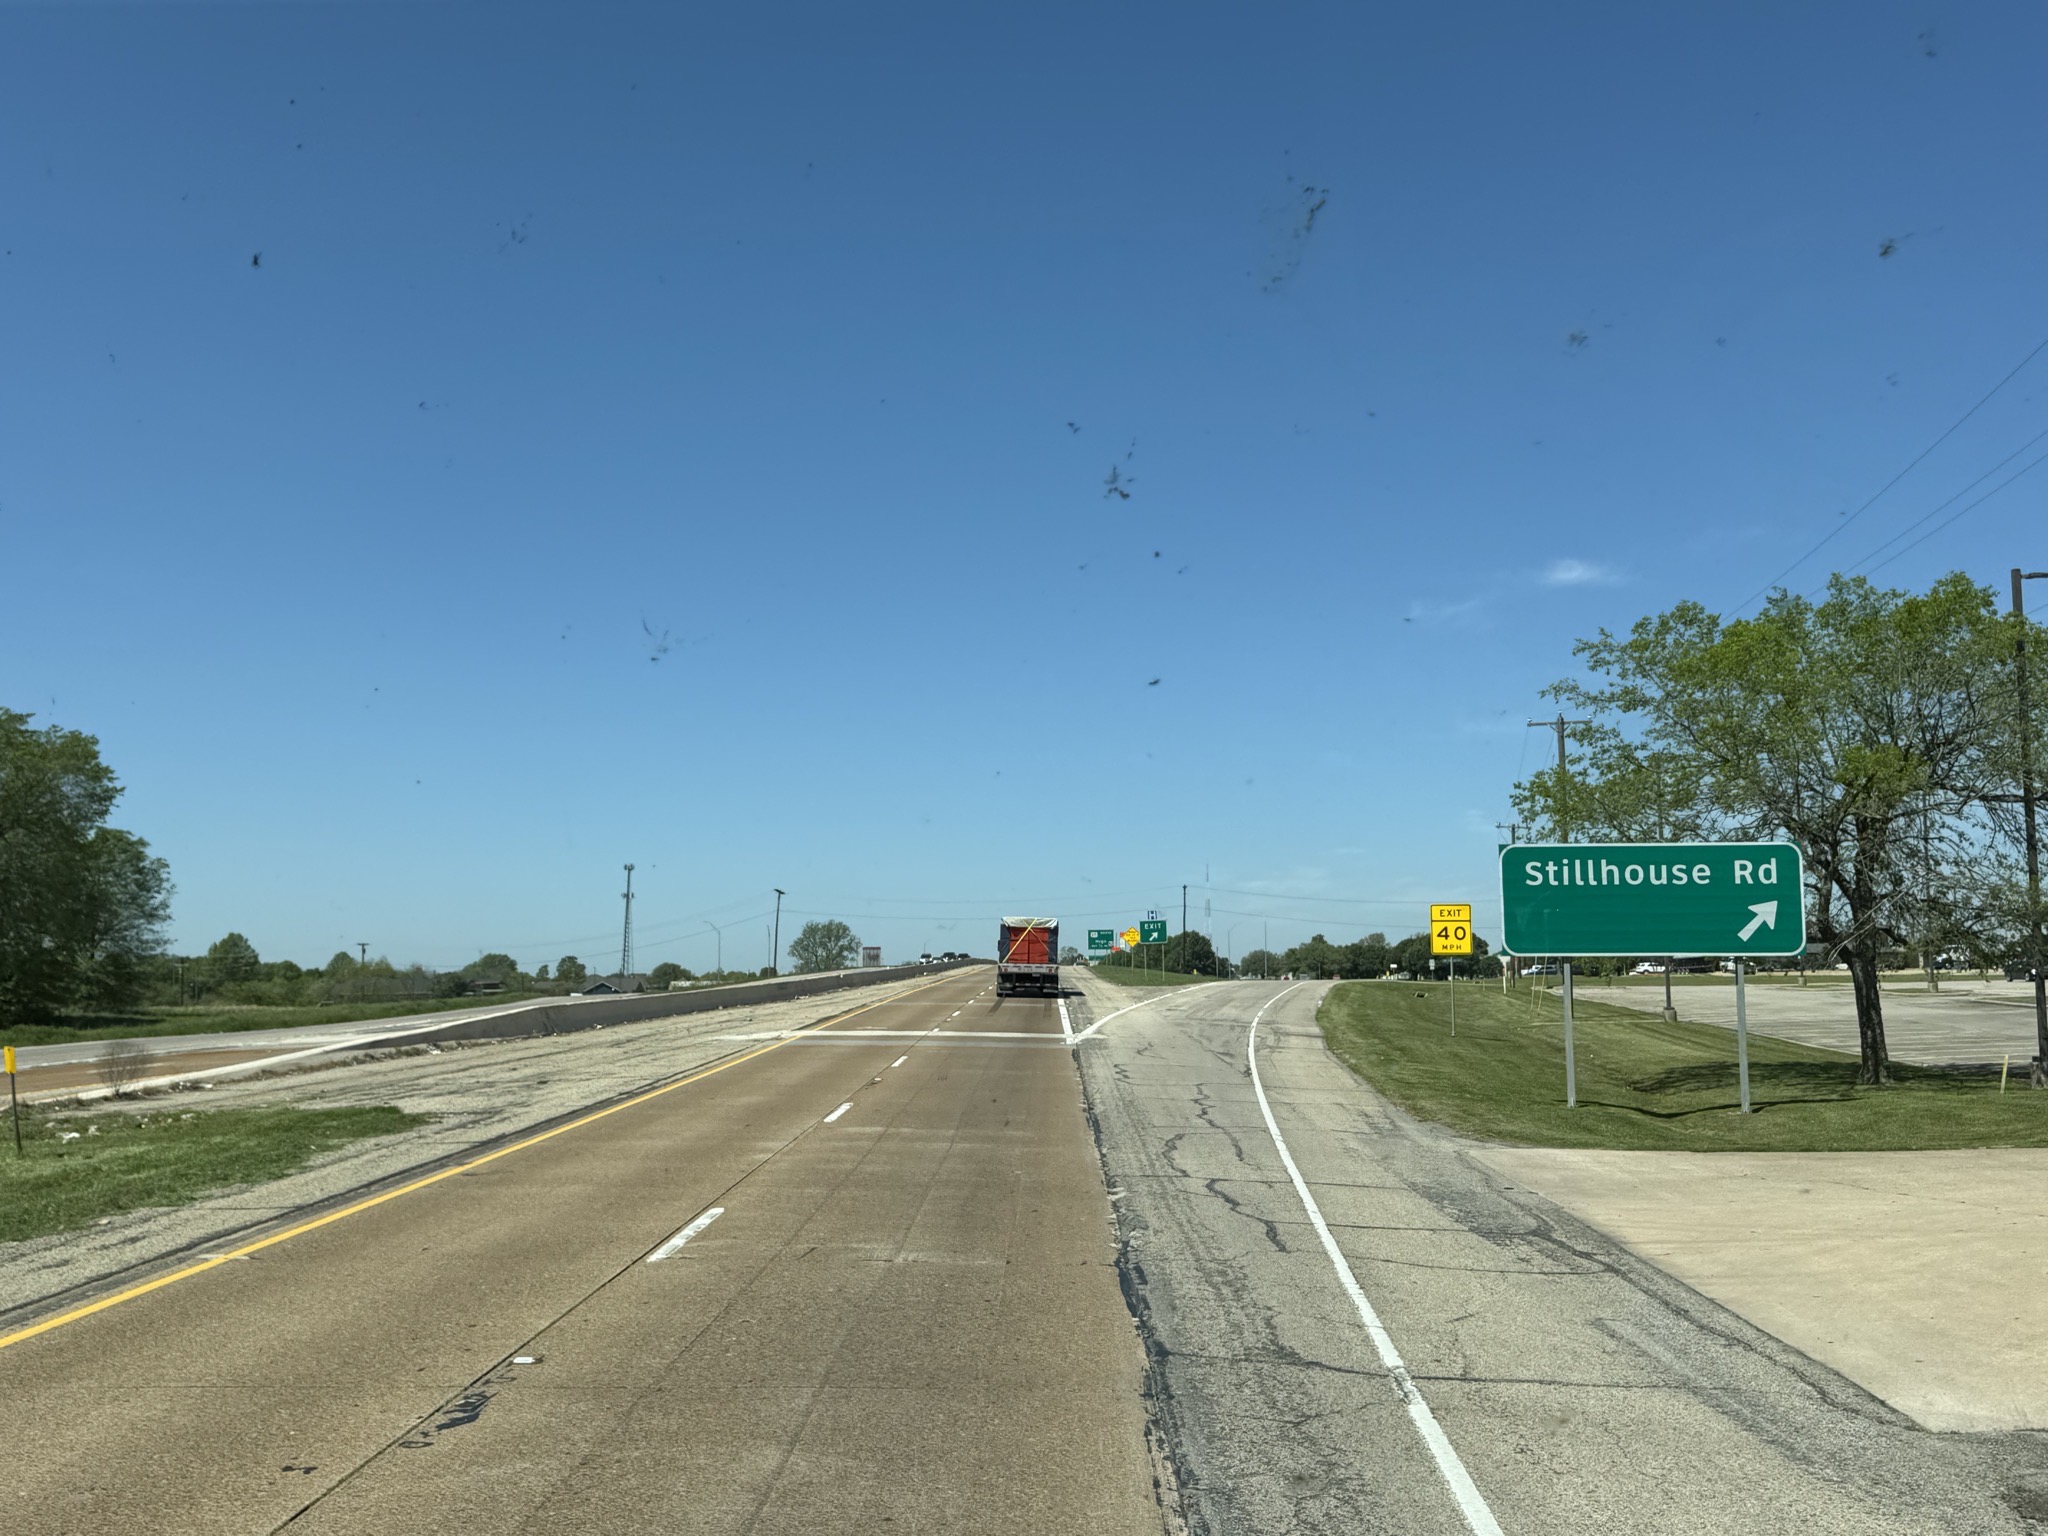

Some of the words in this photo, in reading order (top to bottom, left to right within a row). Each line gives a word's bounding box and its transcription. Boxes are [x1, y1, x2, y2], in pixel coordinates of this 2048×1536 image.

[1525, 858, 1711, 886] Stillhouse
[1734, 857, 1778, 885] Rd
[1440, 909, 1462, 917] EXIT
[1437, 926, 1466, 940] 40
